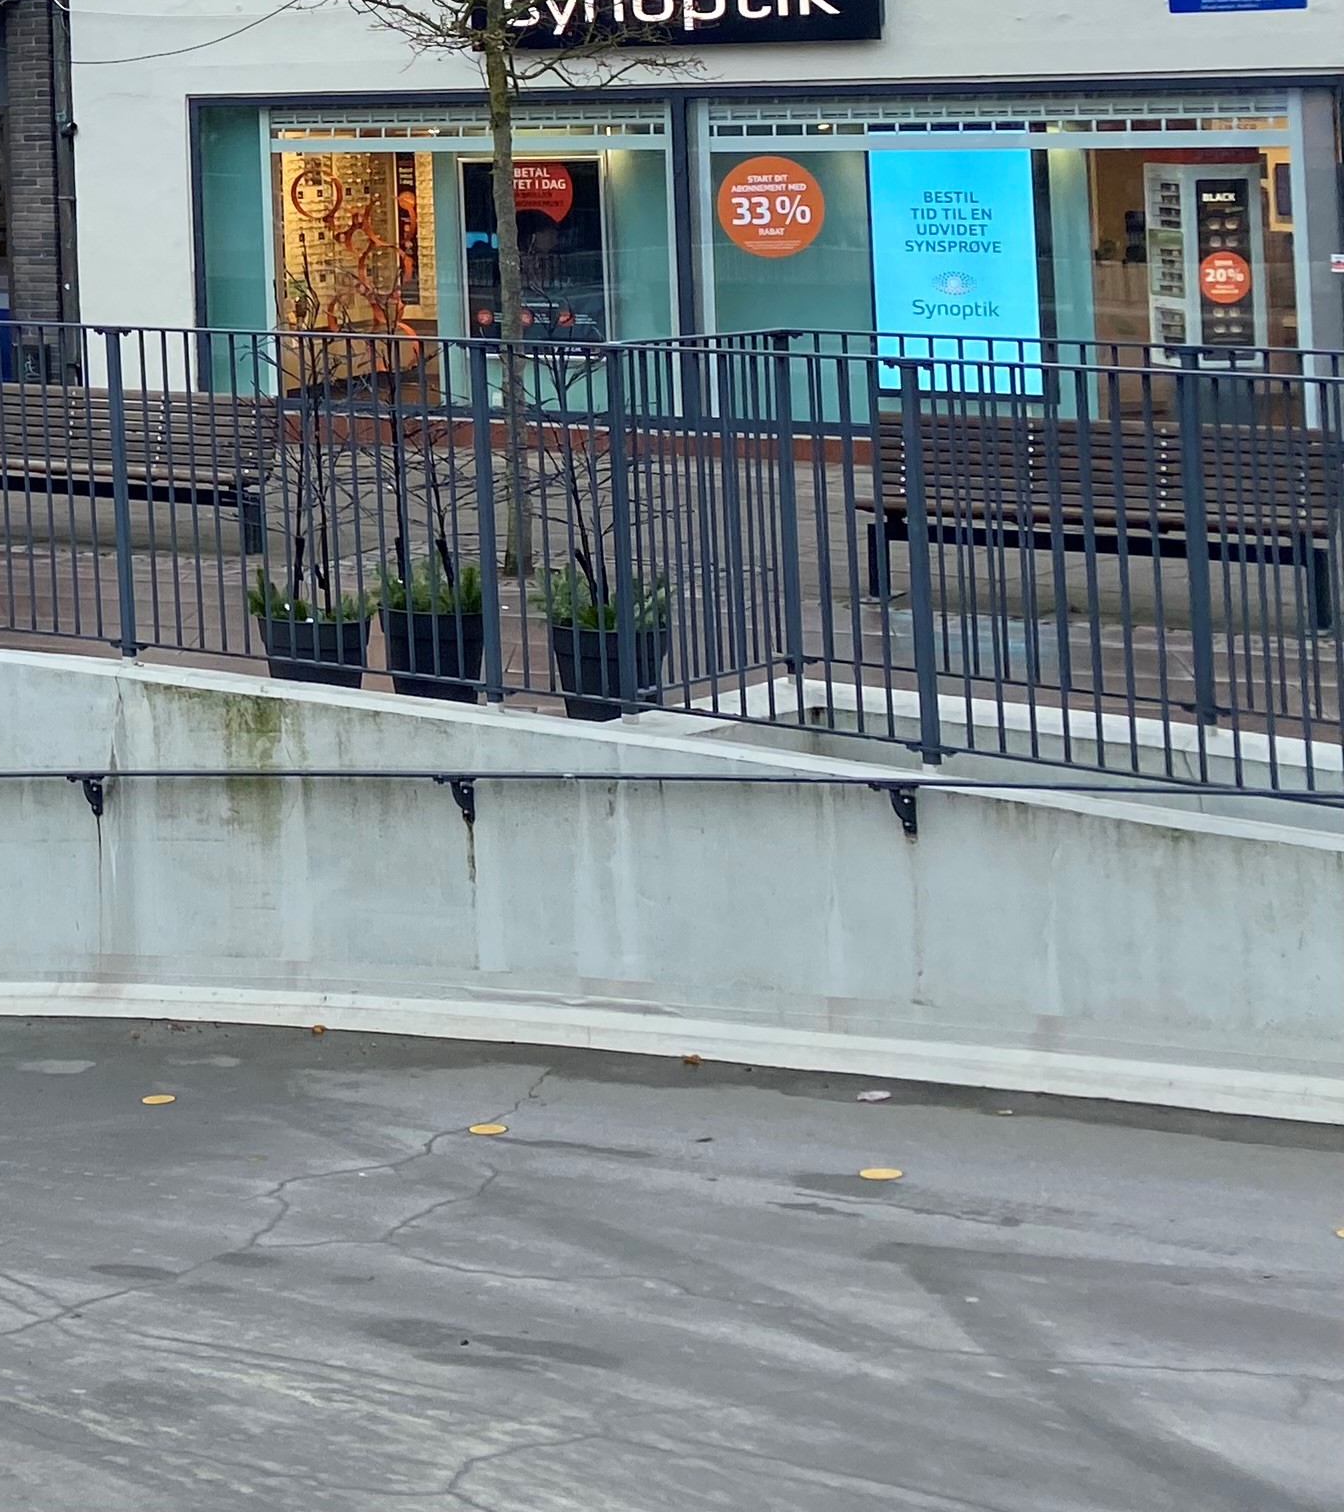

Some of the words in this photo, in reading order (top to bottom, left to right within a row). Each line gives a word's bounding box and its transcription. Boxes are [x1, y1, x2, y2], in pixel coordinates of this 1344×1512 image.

[514, 167, 551, 178] BETAL
[747, 174, 773, 183] START
[774, 174, 789, 182] DIT
[542, 179, 567, 190] DAG
[731, 184, 787, 193] ABONNEMENT
[788, 183, 807, 191] MED
[923, 191, 980, 204] BESTIL
[1202, 192, 1236, 202] BLACK
[910, 208, 938, 220] TID
[941, 208, 967, 220] TIL
[971, 208, 993, 220] EN
[758, 228, 786, 236] RABAT
[916, 223, 988, 236] UDVIDET
[905, 240, 1002, 253] SYNSPRØVE
[1205, 268, 1245, 283] 20%
[912, 299, 1000, 320] Synoptik
